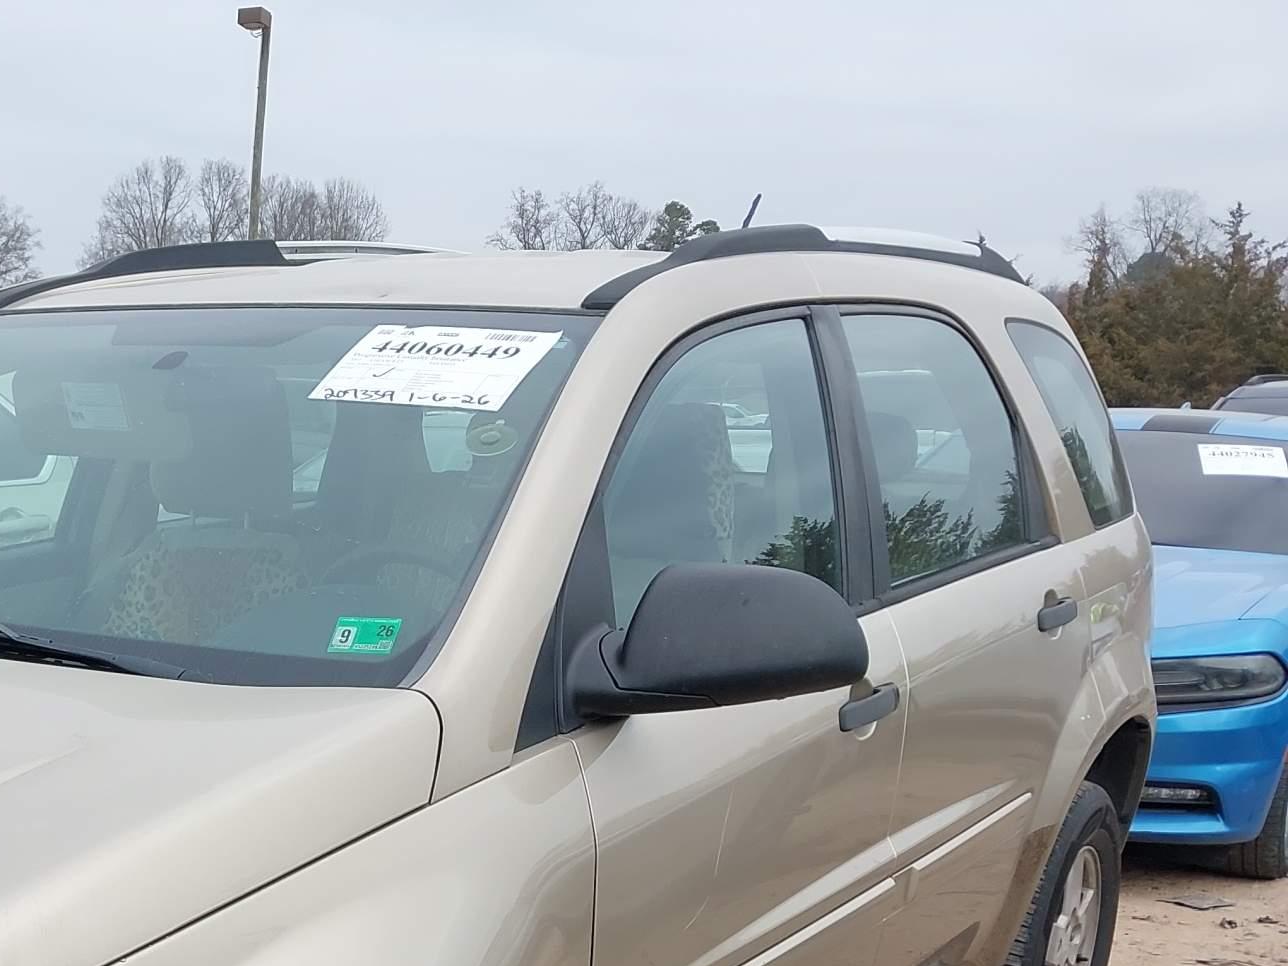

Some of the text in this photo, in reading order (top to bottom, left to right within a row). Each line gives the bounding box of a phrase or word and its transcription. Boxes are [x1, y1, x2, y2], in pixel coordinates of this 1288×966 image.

[371, 340, 521, 360] 44060449
[339, 628, 352, 644] 9
[376, 624, 395, 637] 26
